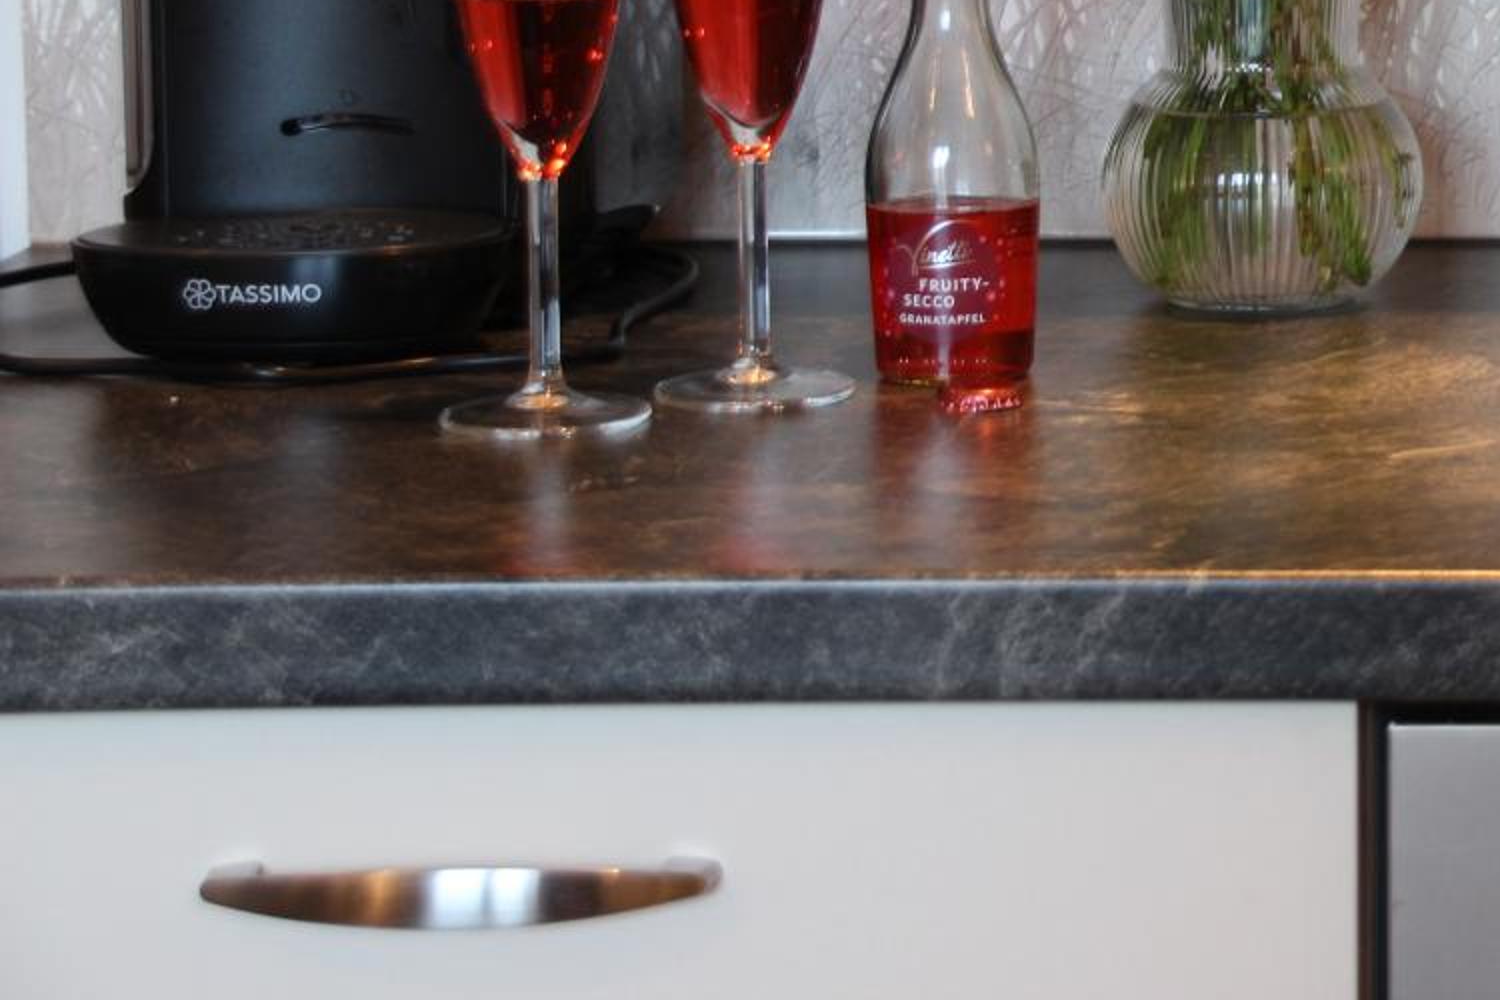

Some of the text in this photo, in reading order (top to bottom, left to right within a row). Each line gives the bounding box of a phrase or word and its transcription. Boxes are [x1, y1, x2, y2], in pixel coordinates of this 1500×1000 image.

[918, 276, 990, 292] FRUITY-
[215, 283, 323, 305] TASSIMO
[903, 293, 956, 309] SECCO
[898, 312, 987, 326] GRANATAPFEL
